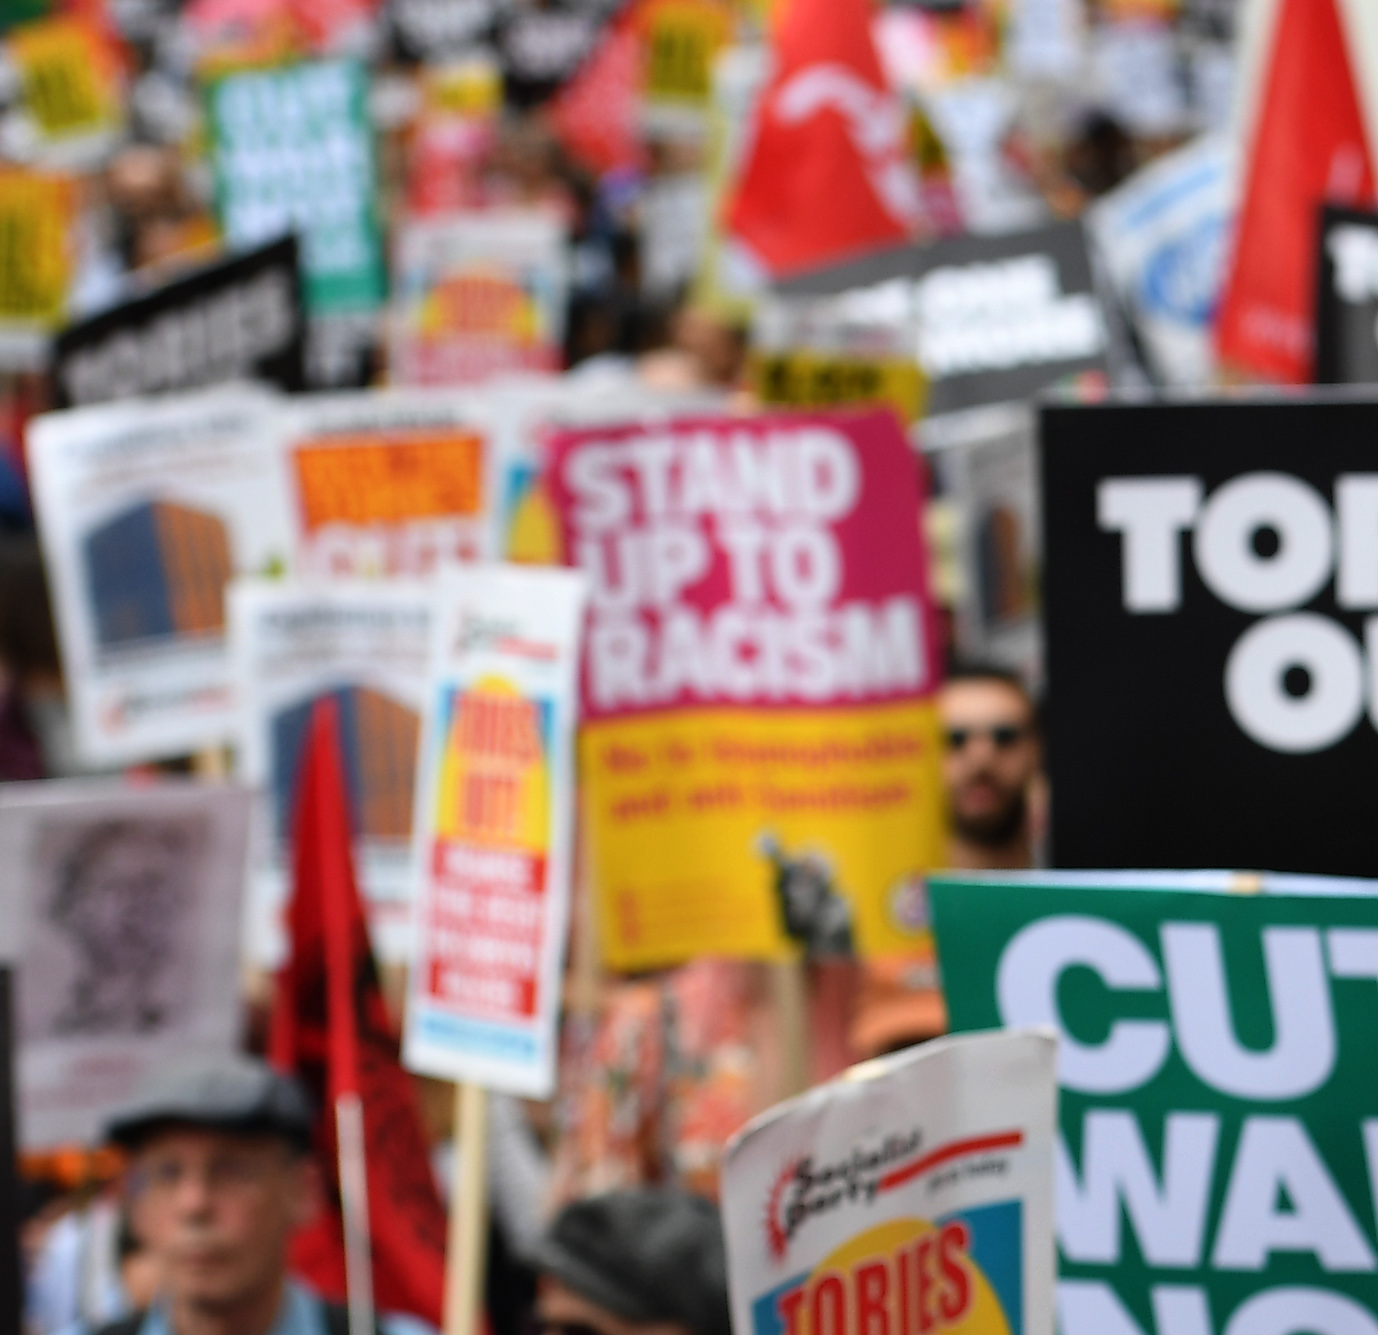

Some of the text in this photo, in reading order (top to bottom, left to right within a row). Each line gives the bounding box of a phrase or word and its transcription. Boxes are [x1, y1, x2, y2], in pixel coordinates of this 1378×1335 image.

[566, 426, 862, 530] STAND
[718, 525, 841, 606] TO
[591, 593, 927, 710] RACISM
